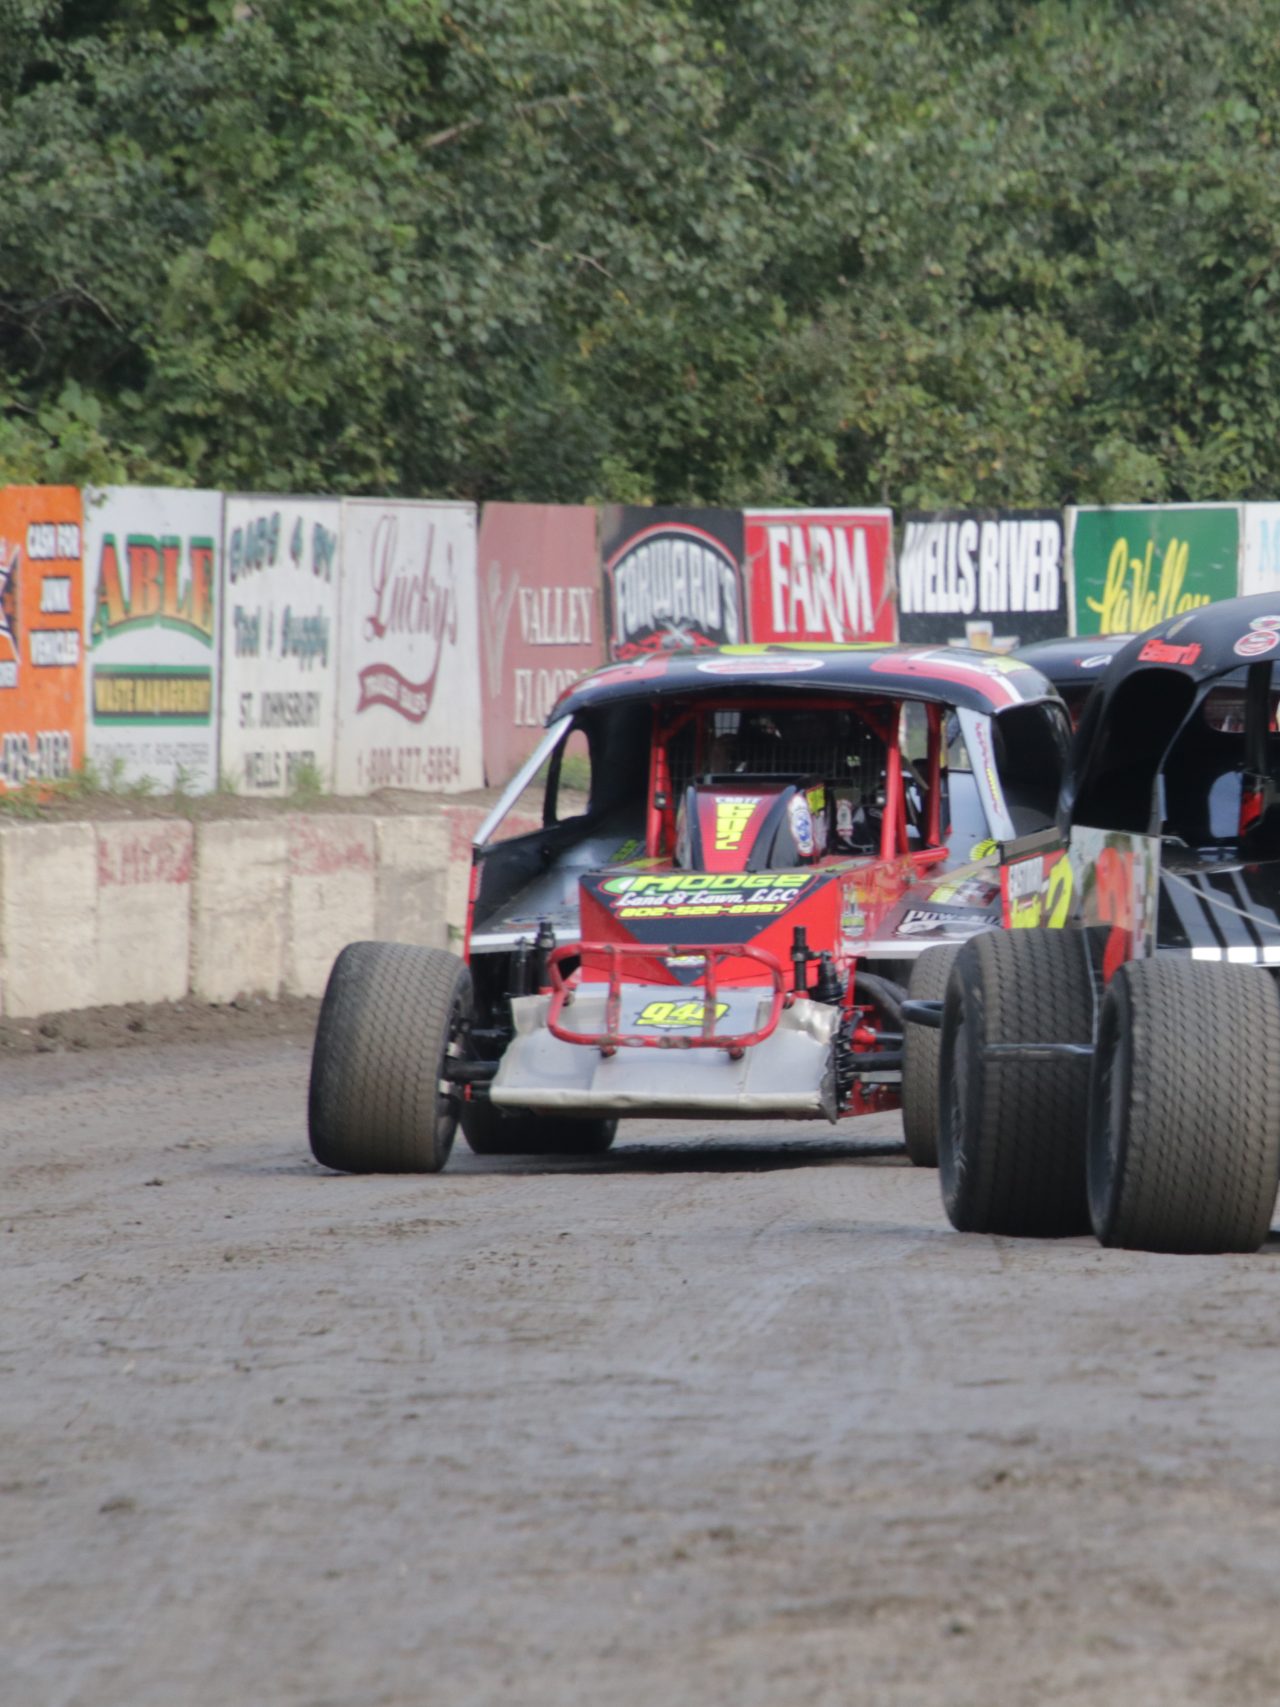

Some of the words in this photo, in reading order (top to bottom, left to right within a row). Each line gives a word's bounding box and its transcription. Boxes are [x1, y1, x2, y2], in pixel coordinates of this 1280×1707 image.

[90, 532, 214, 650] ABLE
[767, 525, 875, 642] FARM
[901, 521, 977, 614] WELLS
[979, 520, 1061, 612] RIVER
[518, 586, 594, 645] VALLEY
[715, 803, 758, 850] 602
[615, 892, 667, 907] Land
[748, 888, 800, 903] LLC
